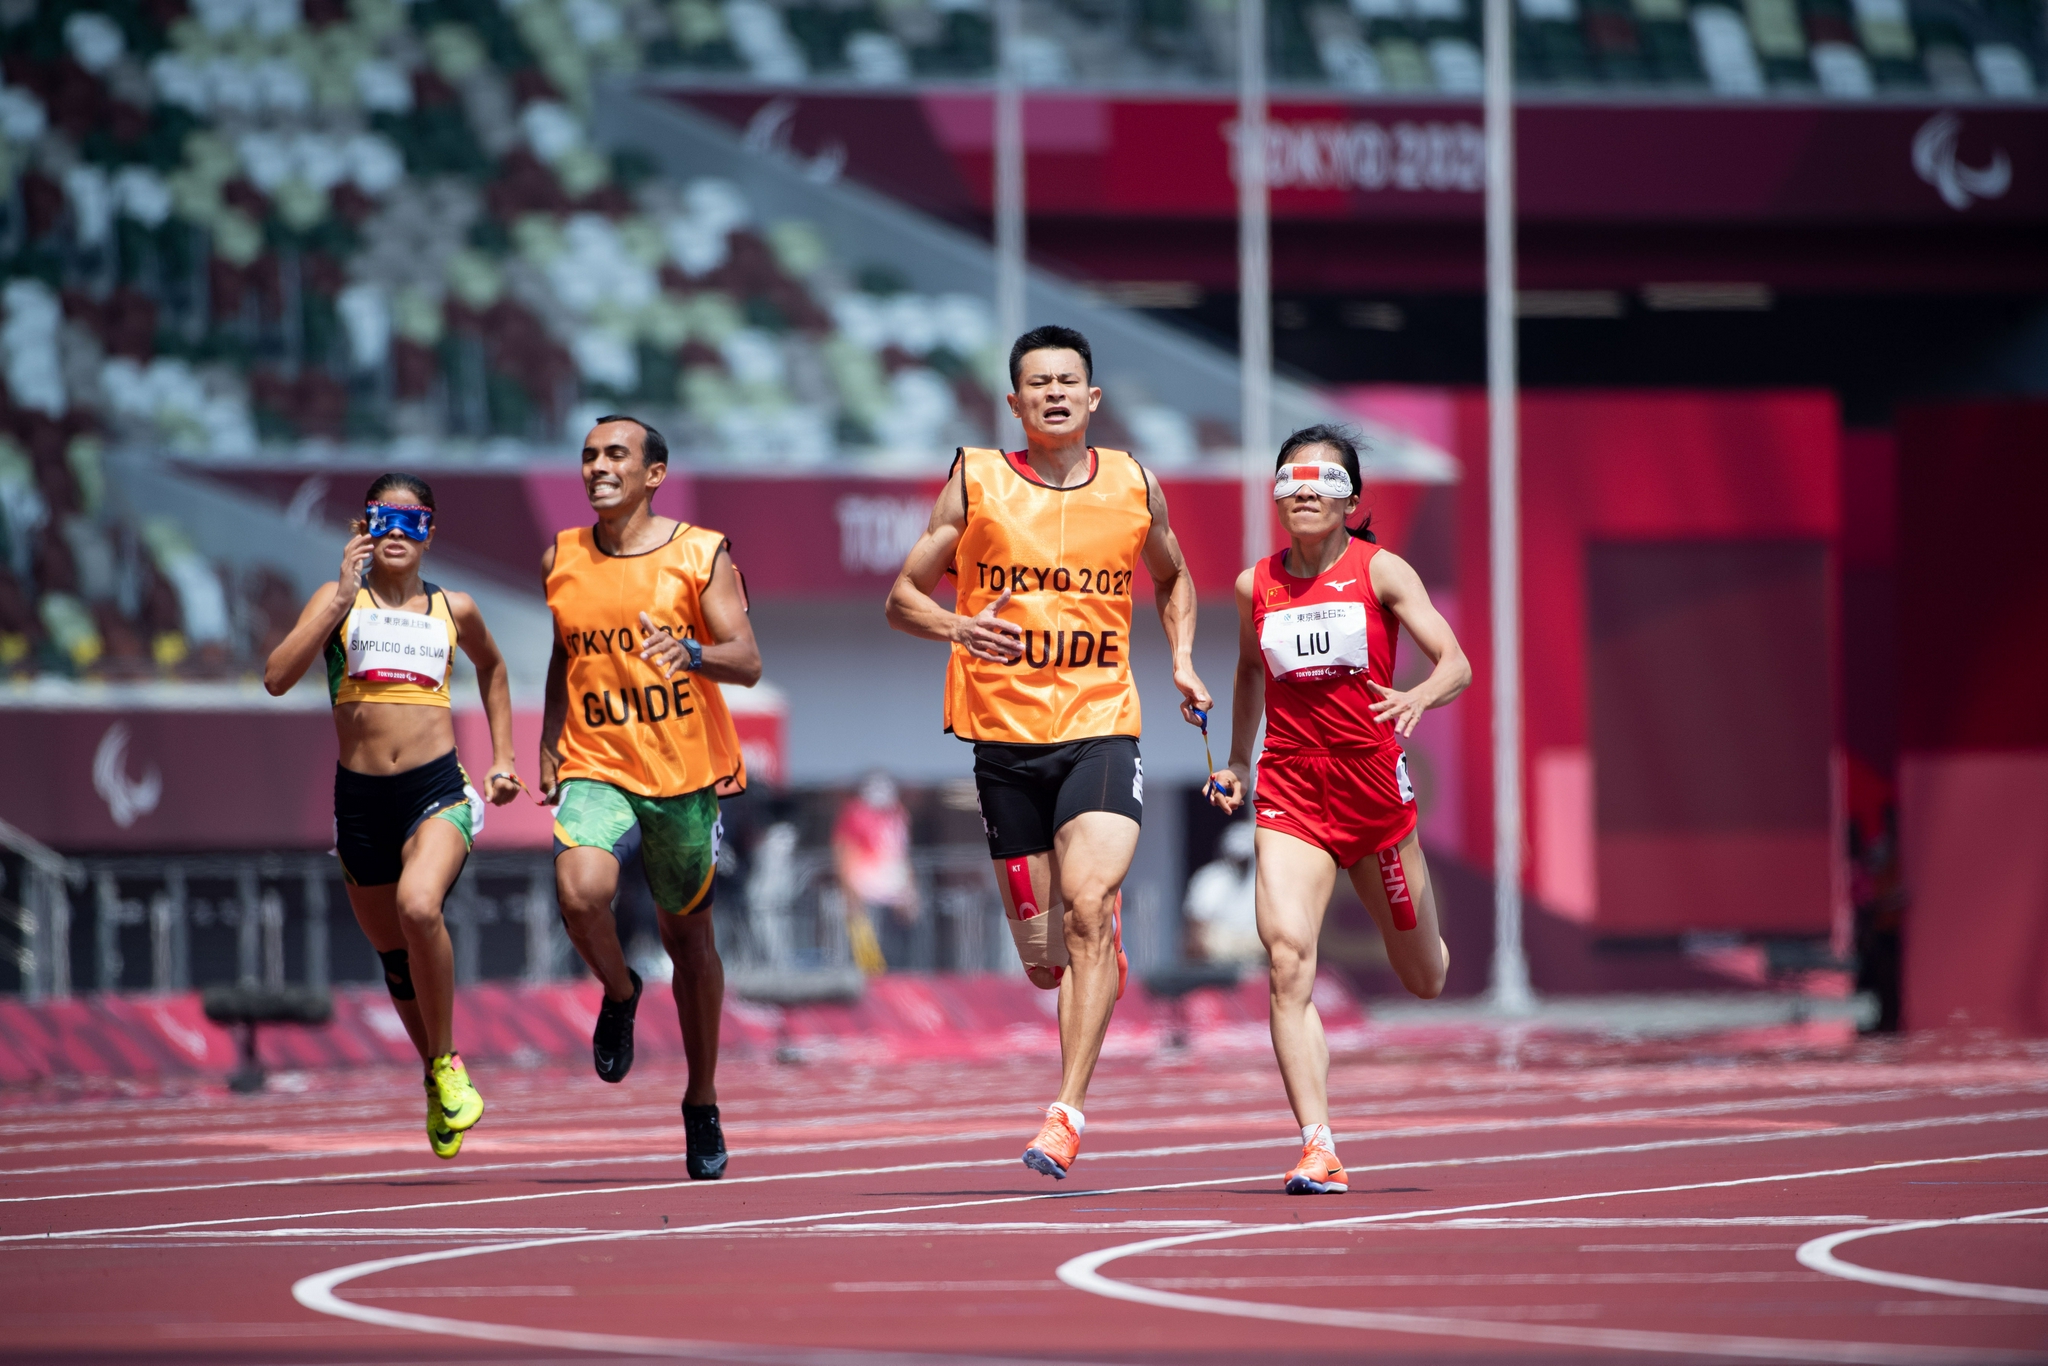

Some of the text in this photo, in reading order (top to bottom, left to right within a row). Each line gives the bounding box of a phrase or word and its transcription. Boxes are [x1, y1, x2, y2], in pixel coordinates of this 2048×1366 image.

[1394, 122, 1487, 190] 202
[976, 562, 1071, 592] TOKYO
[351, 640, 444, 659] SIMPLICIO da SILVA
[567, 627, 634, 659] OKYO
[1296, 631, 1330, 657] LIU
[583, 678, 694, 728] GUIDE
[1012, 864, 1021, 872] KT
[1378, 847, 1409, 904] CHN
